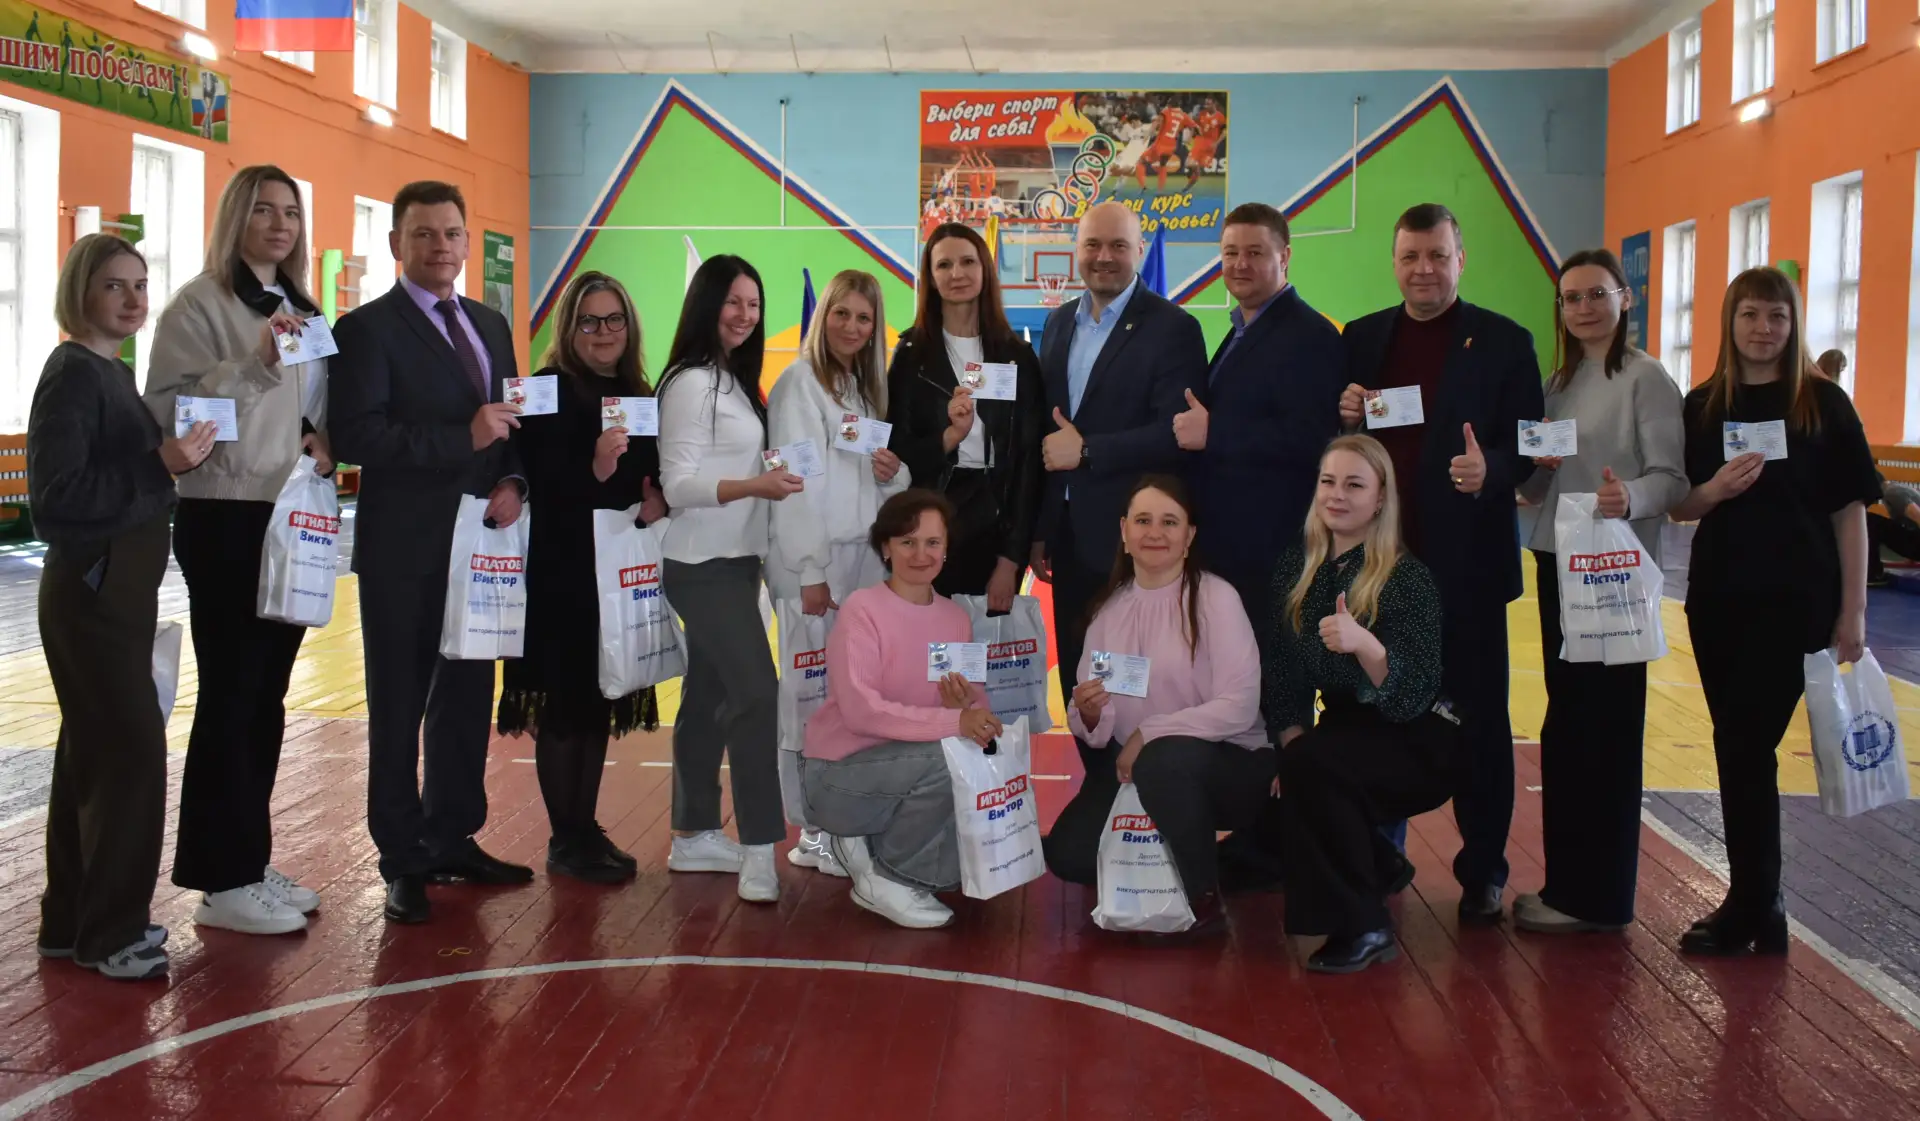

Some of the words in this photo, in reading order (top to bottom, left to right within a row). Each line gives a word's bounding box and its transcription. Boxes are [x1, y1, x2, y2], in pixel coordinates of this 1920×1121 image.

[69, 42, 175, 96] победам
[927, 100, 996, 123] Выбери
[1002, 96, 1058, 115] спорт
[950, 122, 981, 142] для
[988, 116, 1037, 138] себя!
[1165, 119, 1180, 139] 3
[1150, 193, 1192, 214] курс
[1141, 208, 1220, 232] доровье!
[988, 798, 1024, 821] Витор
